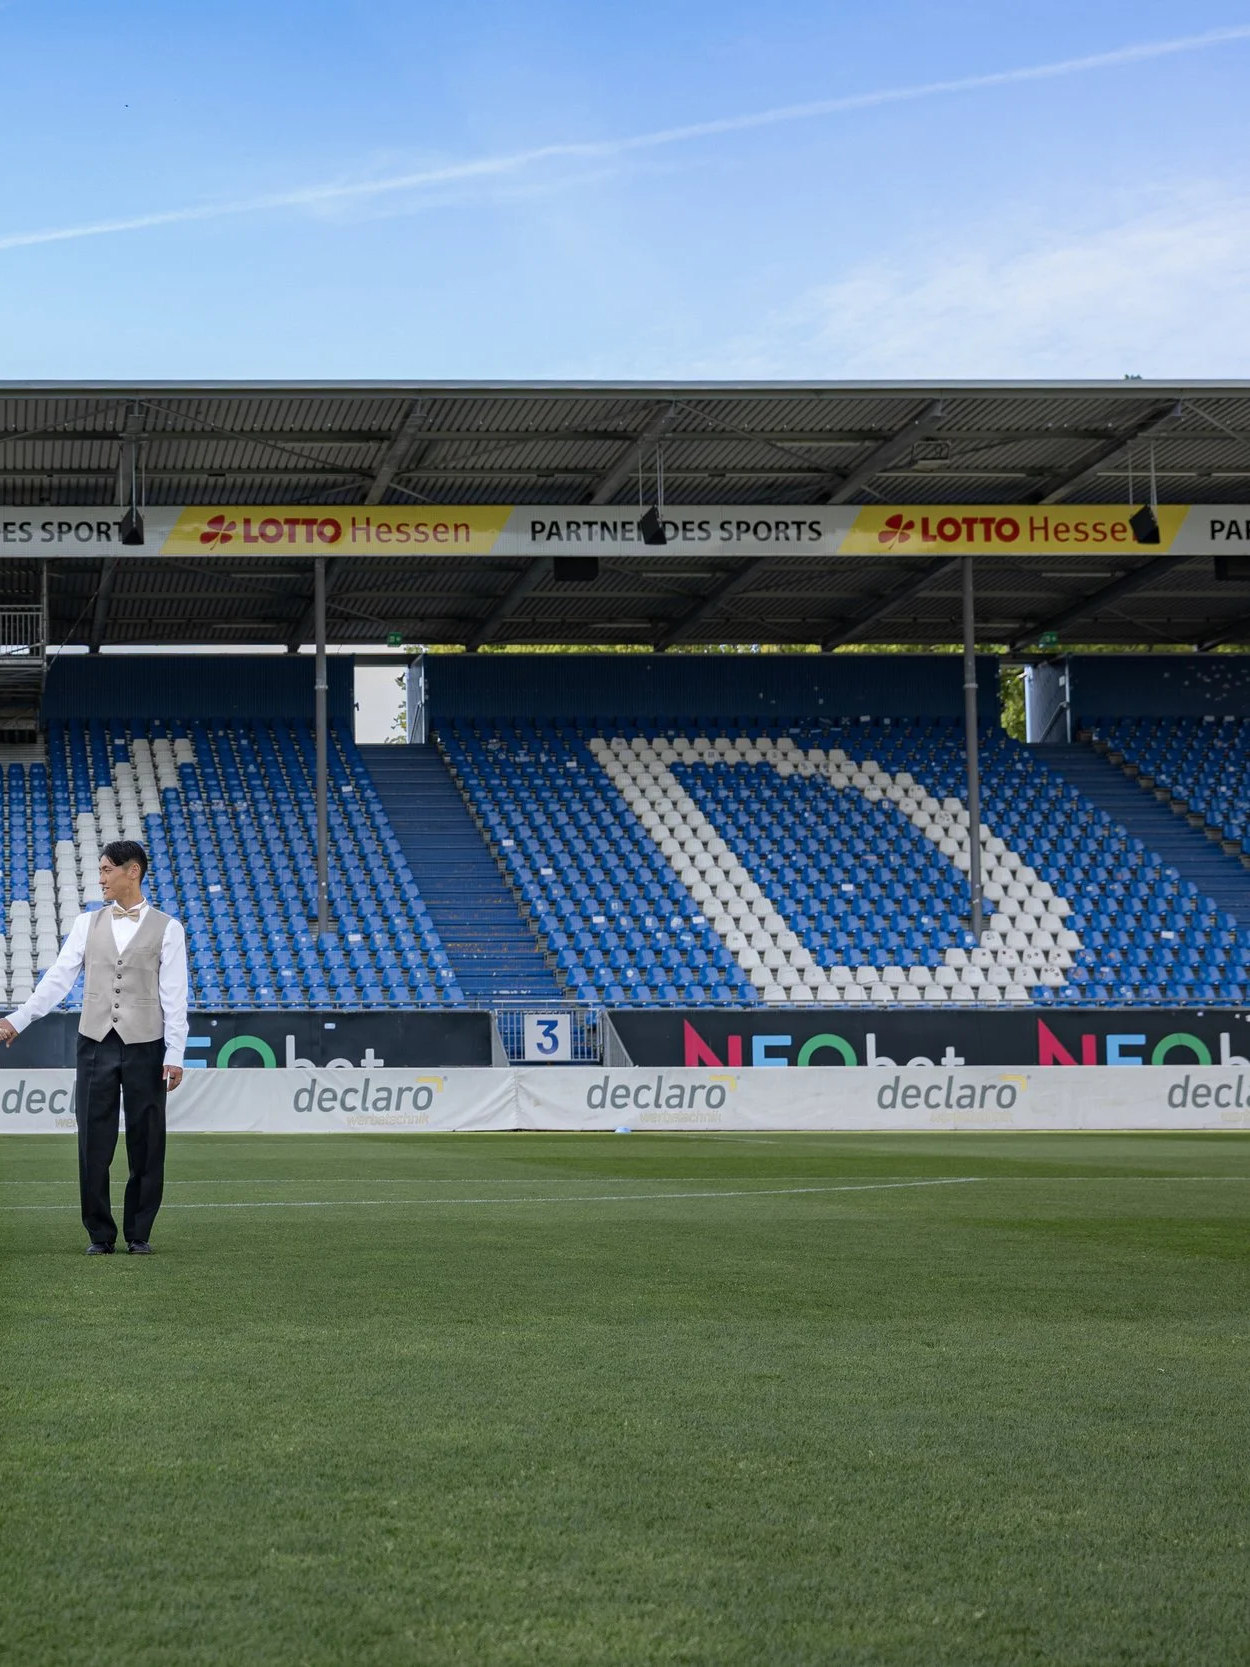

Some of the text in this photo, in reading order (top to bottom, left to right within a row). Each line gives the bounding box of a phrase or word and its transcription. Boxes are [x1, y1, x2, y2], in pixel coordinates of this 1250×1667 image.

[40, 521, 123, 543] SPORT
[243, 517, 470, 544] LOTTO Hessen
[530, 520, 822, 542] PARTNE DES SPORTS
[921, 516, 1137, 543] LOTTO Hesse
[1210, 519, 1250, 541] PA
[536, 1019, 559, 1055] 3
[293, 1077, 433, 1112] declaro
[586, 1075, 726, 1109] declaro
[877, 1075, 1017, 1109] declaro
[1167, 1074, 1250, 1108] decl
